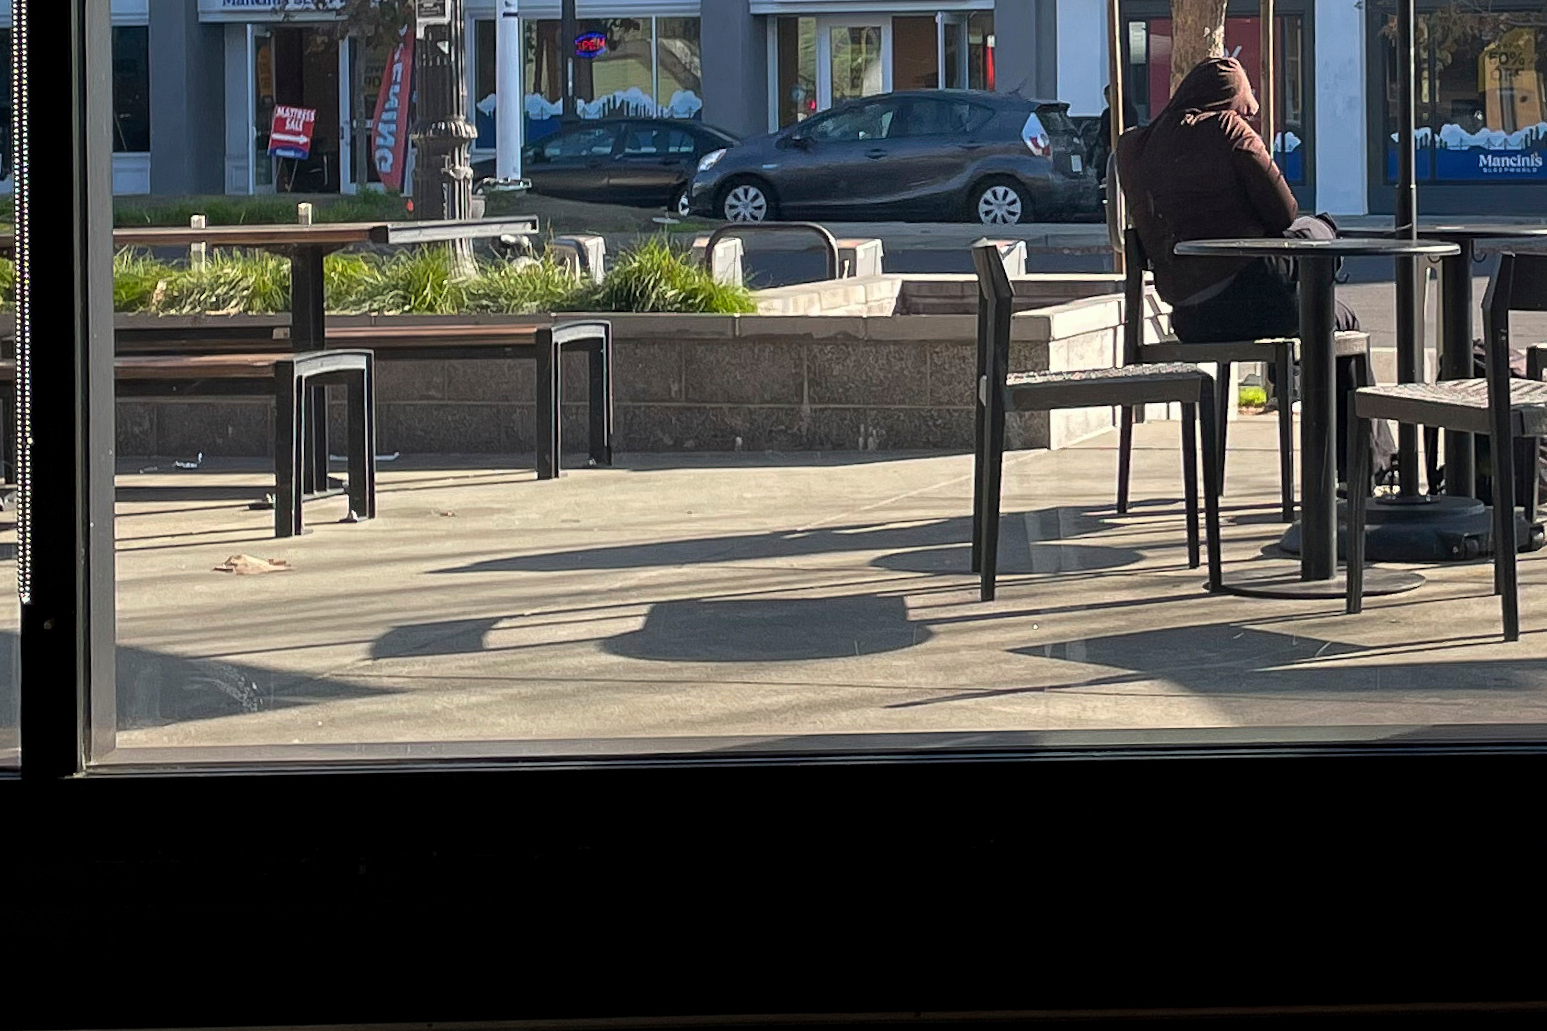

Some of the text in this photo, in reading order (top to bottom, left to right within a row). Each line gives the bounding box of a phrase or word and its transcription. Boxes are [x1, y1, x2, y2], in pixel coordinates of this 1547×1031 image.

[275, 105, 317, 122] MATTRESS
[284, 117, 305, 132] SALE
[1478, 151, 1543, 168] Mancini's
